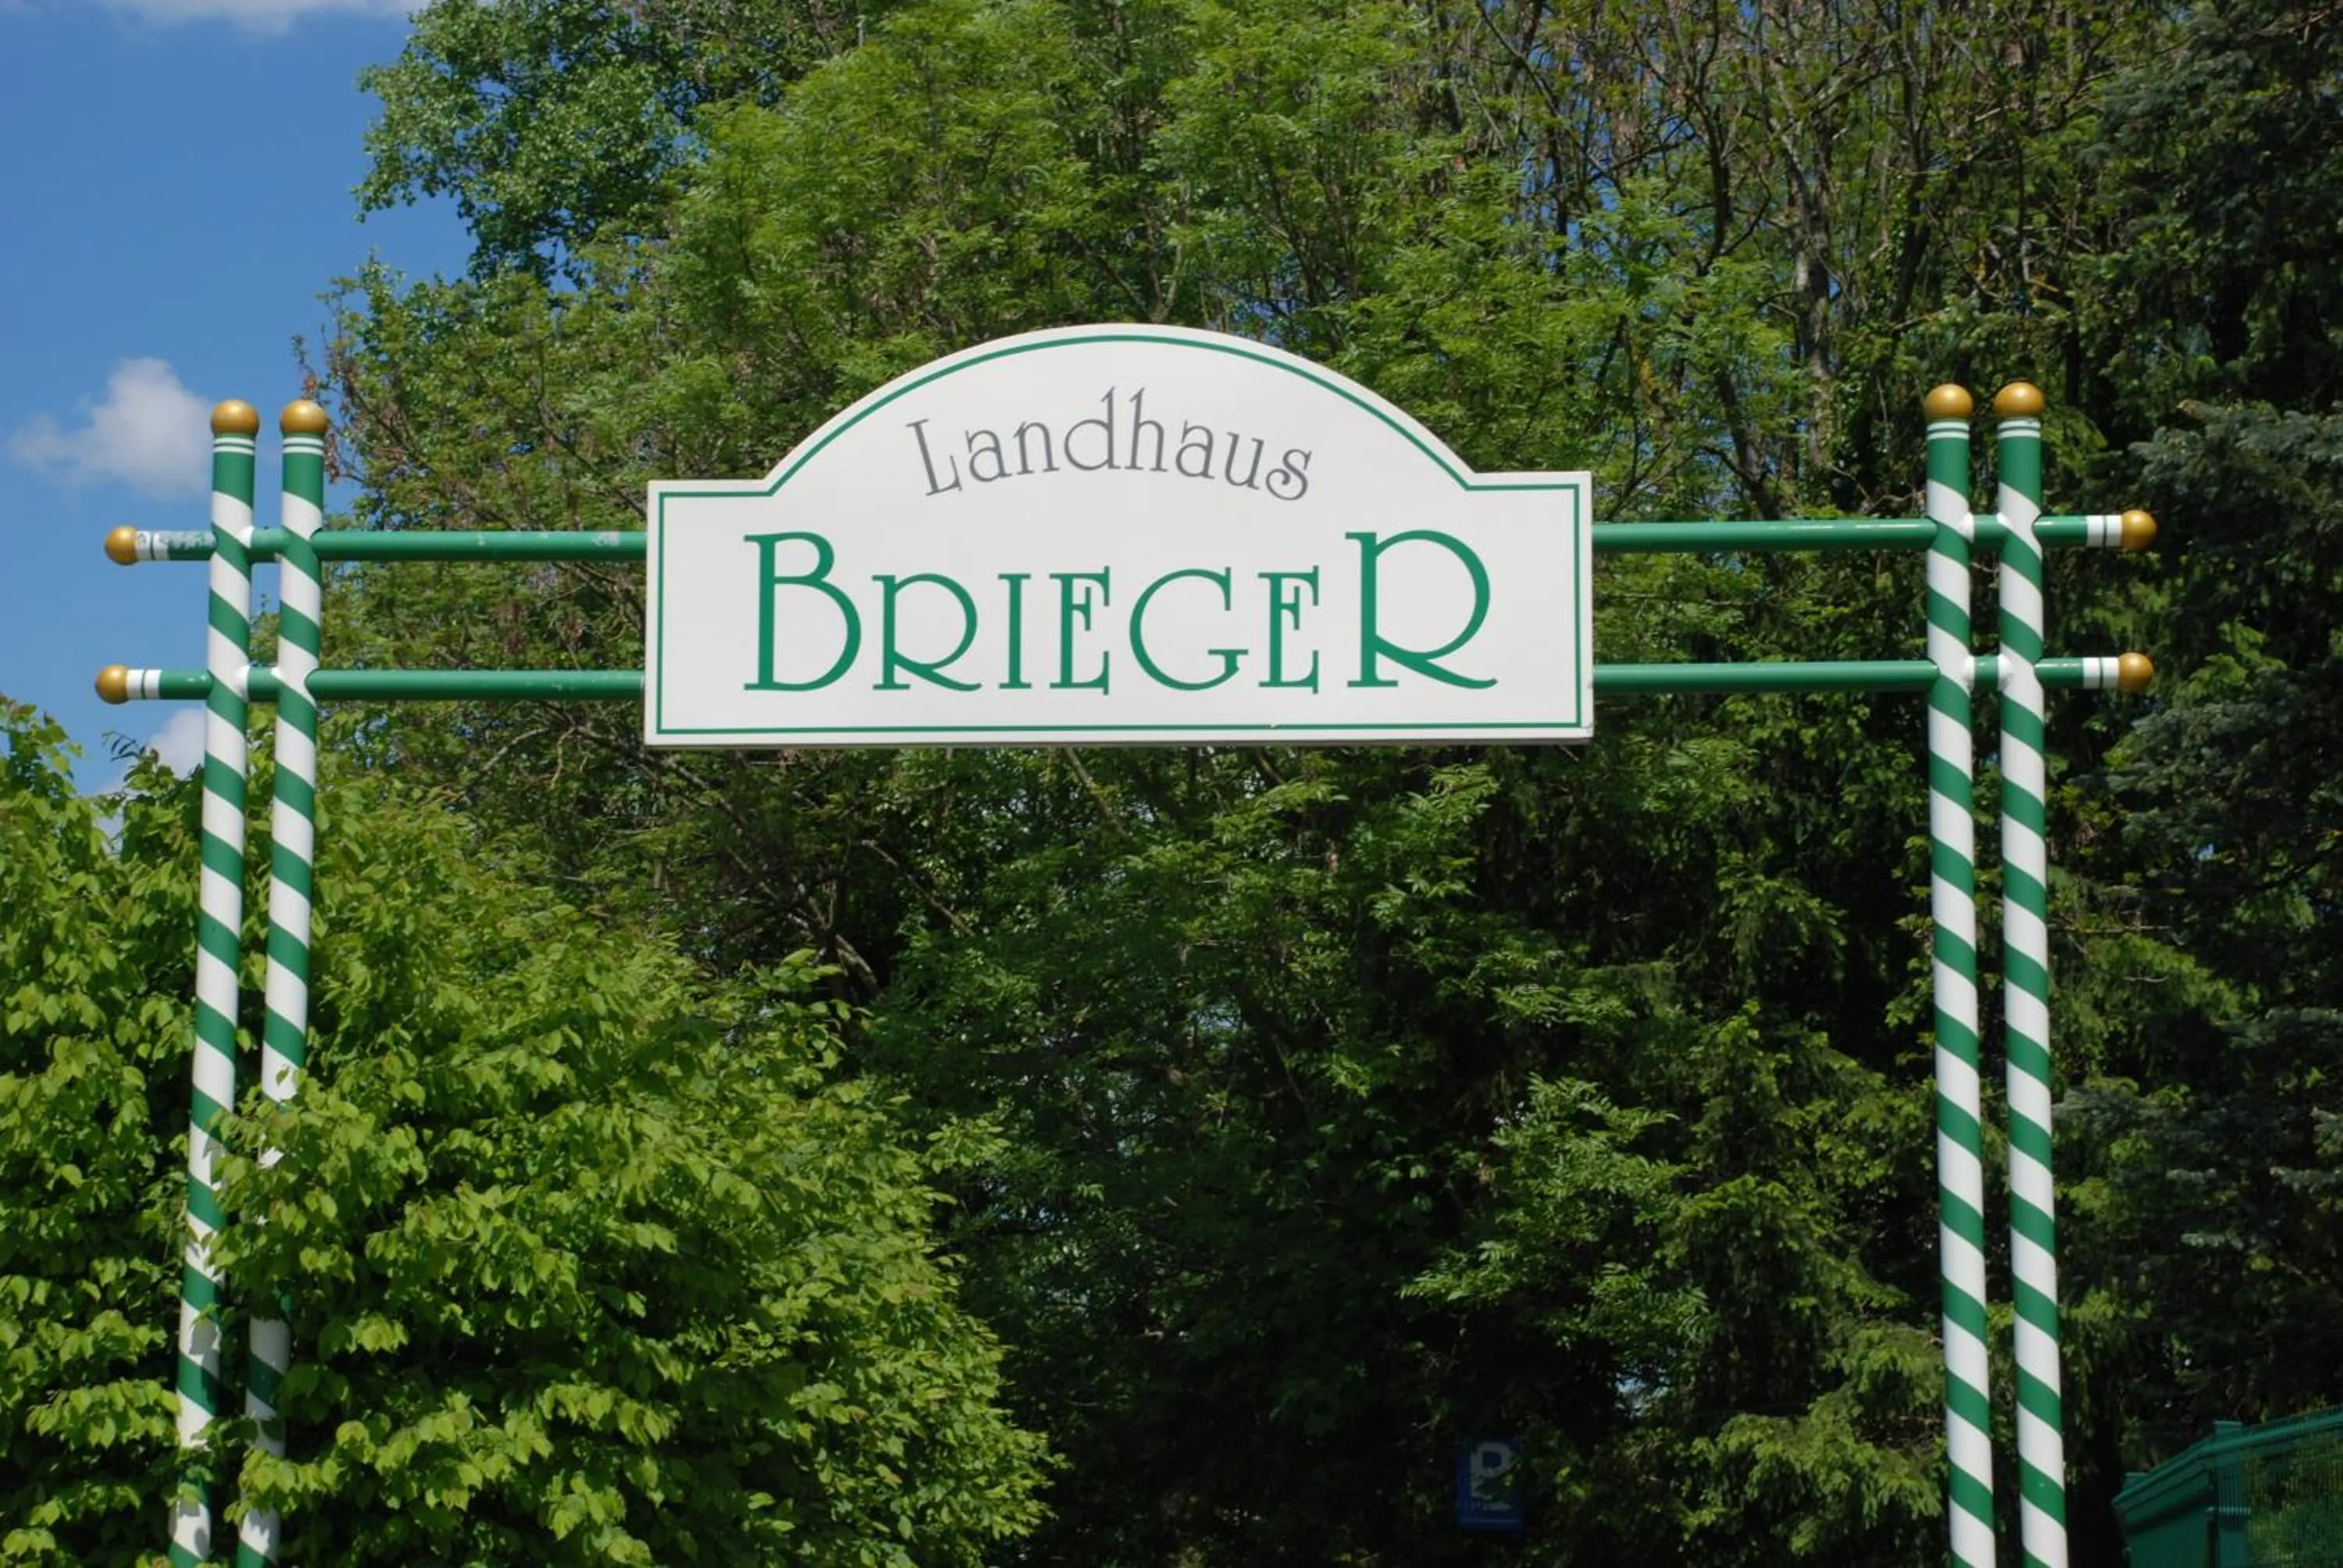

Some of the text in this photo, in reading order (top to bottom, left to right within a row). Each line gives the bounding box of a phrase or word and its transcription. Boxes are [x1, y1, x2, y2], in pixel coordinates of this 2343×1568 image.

[906, 387, 1313, 501] Landhaus
[743, 529, 1498, 695] BRIEGER
[1471, 1441, 1513, 1497] P
